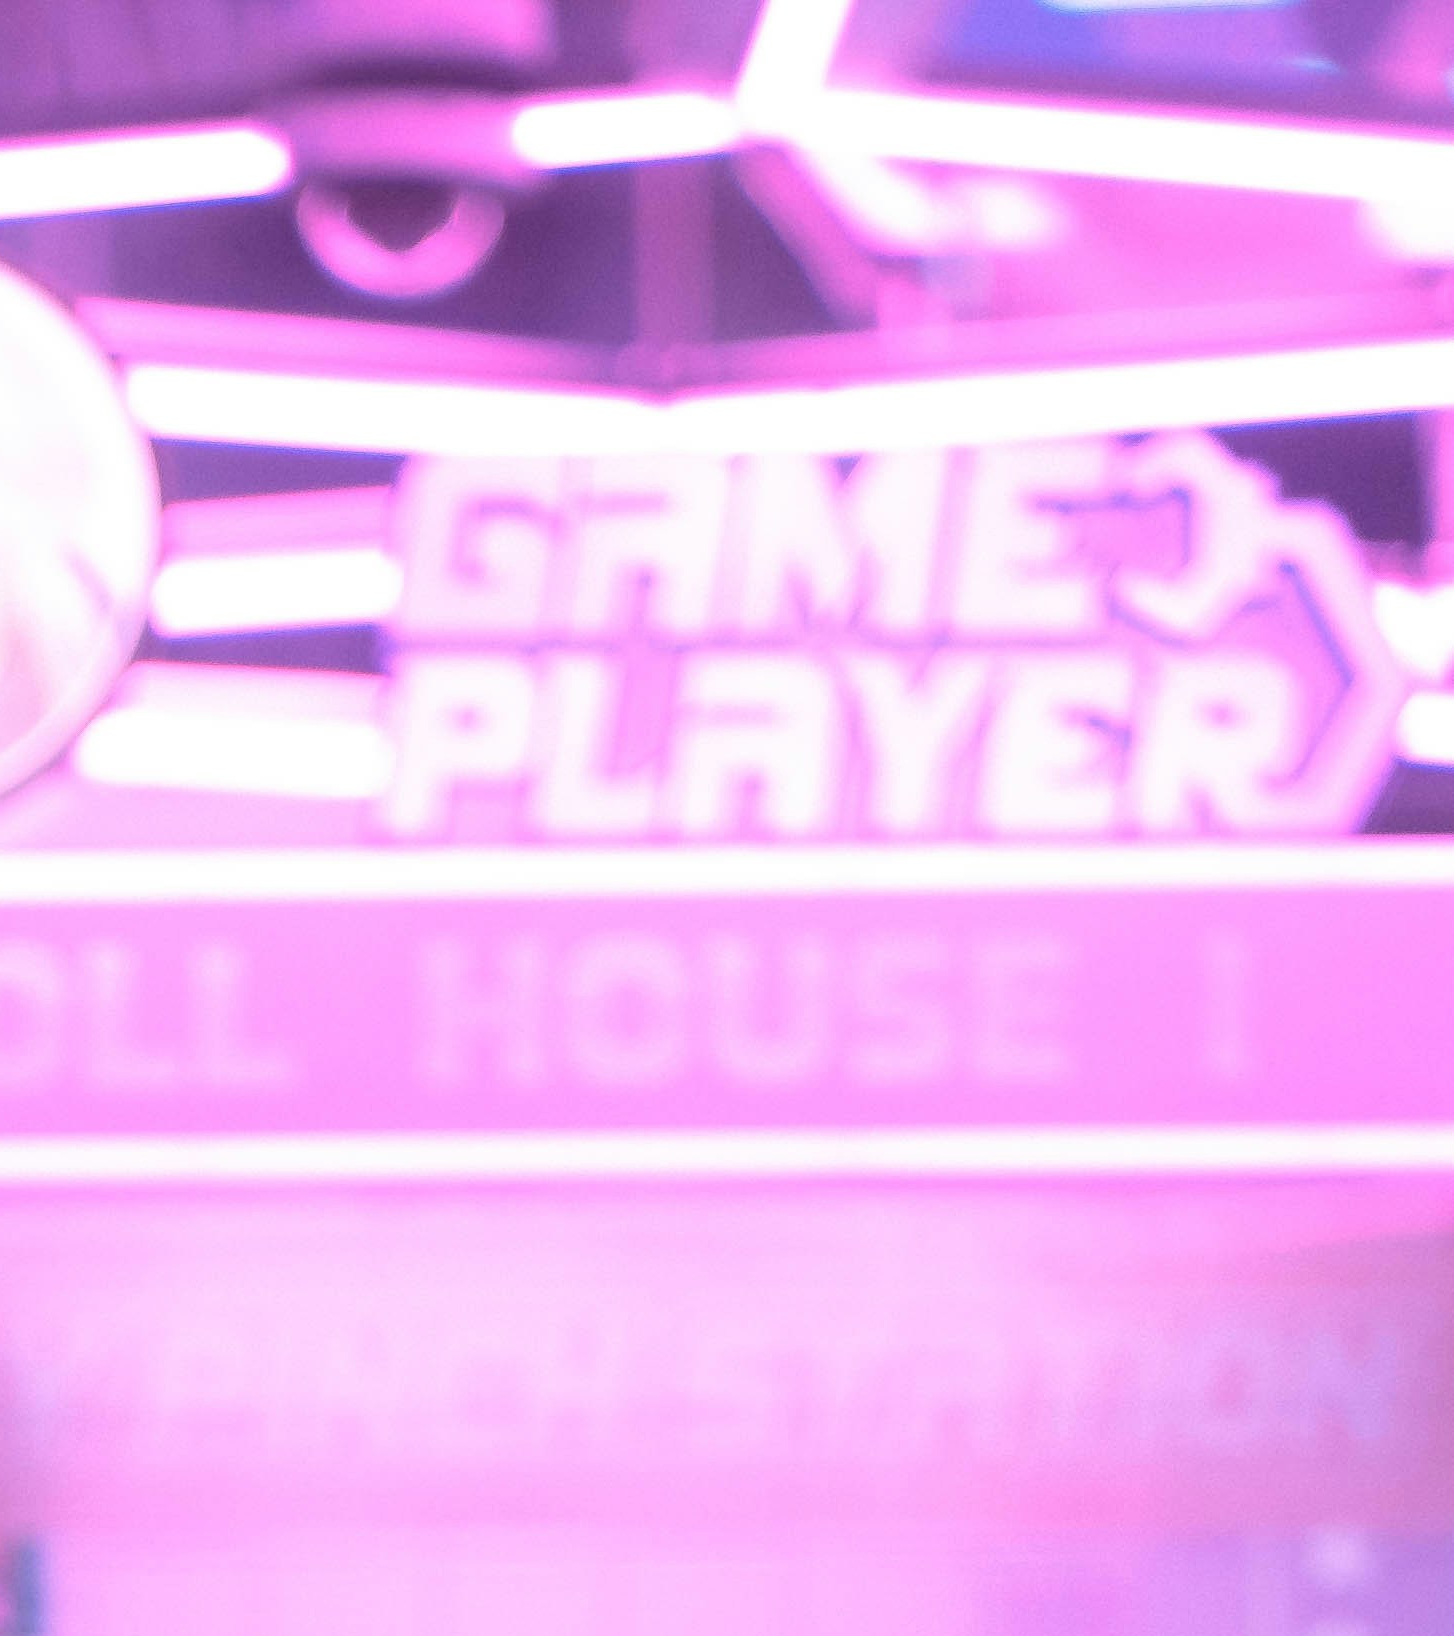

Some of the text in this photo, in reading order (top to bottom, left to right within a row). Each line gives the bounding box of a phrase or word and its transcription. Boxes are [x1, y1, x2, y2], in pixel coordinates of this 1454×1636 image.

[398, 452, 1104, 636] GAME
[380, 652, 1292, 836] PLAYER
[410, 930, 1072, 1092] HOUSE
